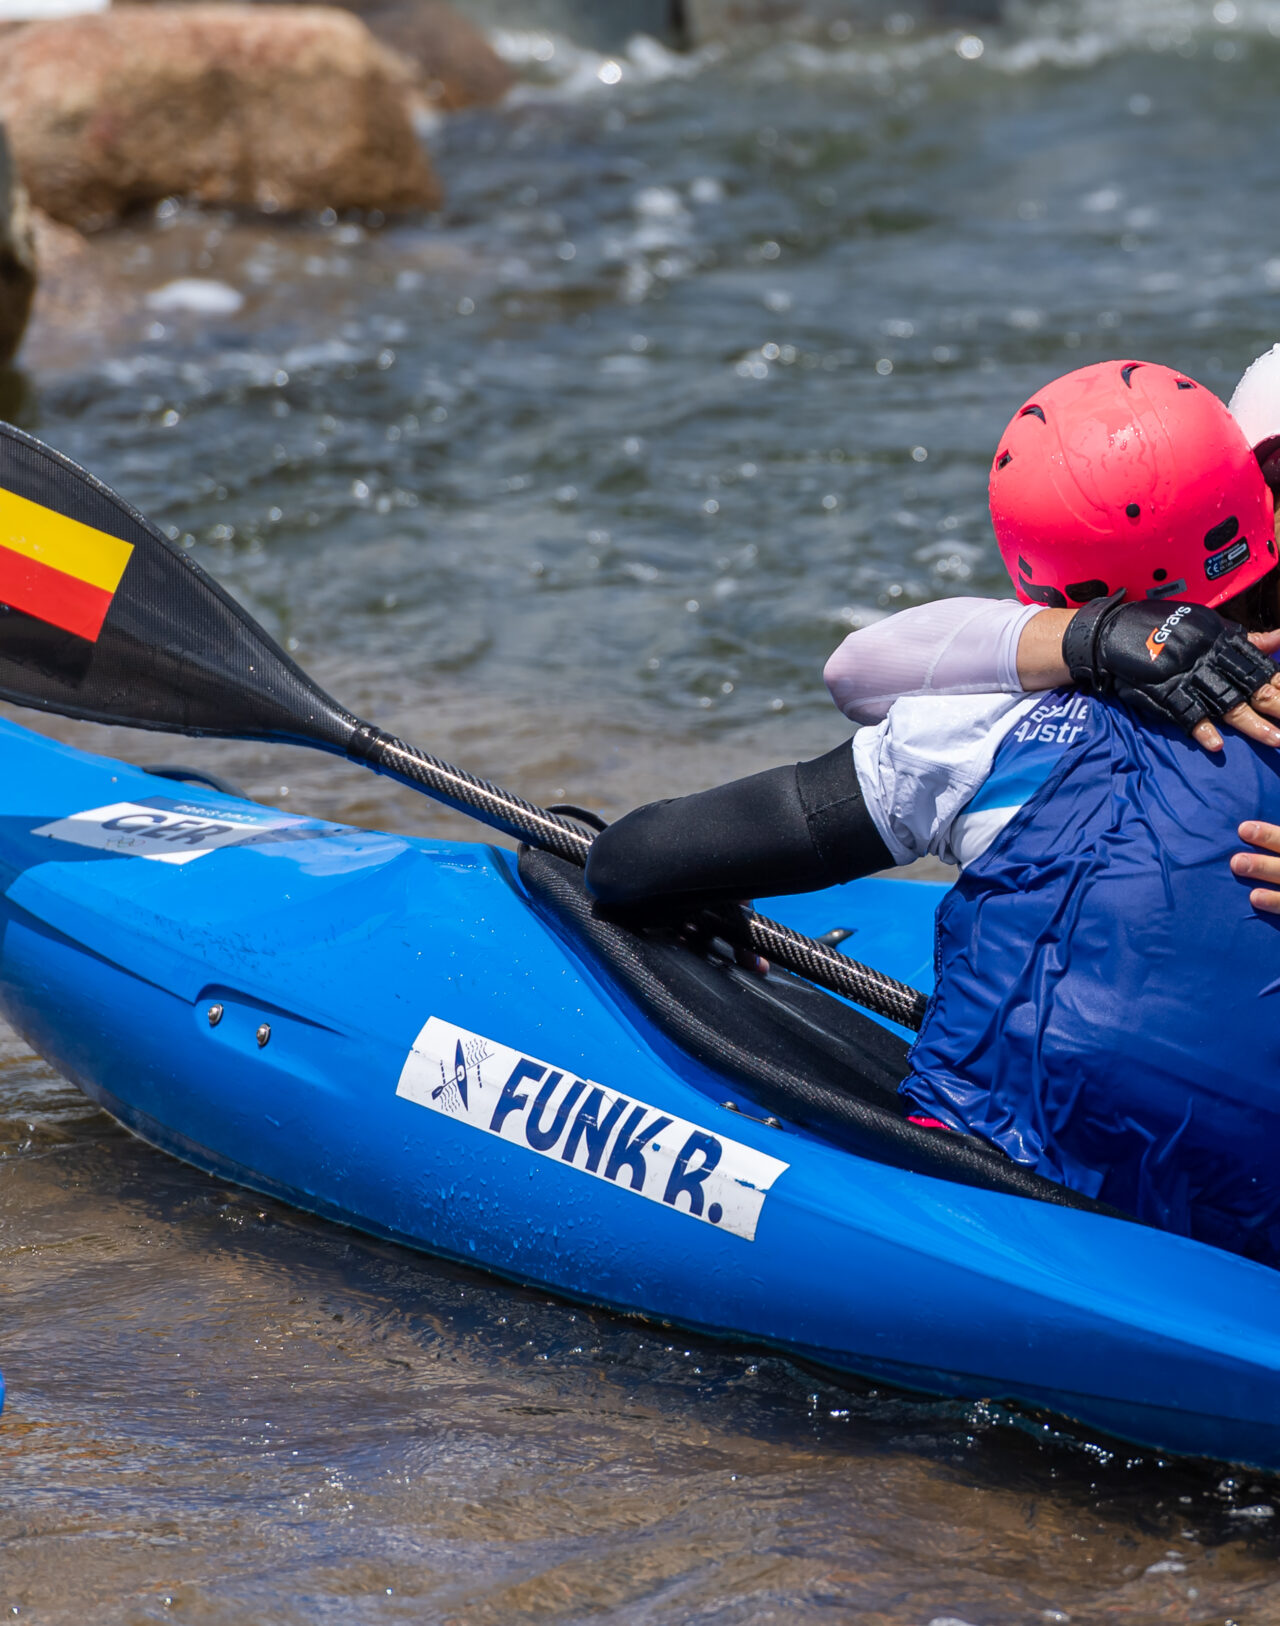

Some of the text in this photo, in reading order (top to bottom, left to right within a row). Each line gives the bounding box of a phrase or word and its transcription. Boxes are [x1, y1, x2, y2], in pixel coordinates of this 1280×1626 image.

[1153, 605, 1192, 643] Grays
[101, 813, 234, 846] GER
[489, 1057, 724, 1225] FUNK R.
